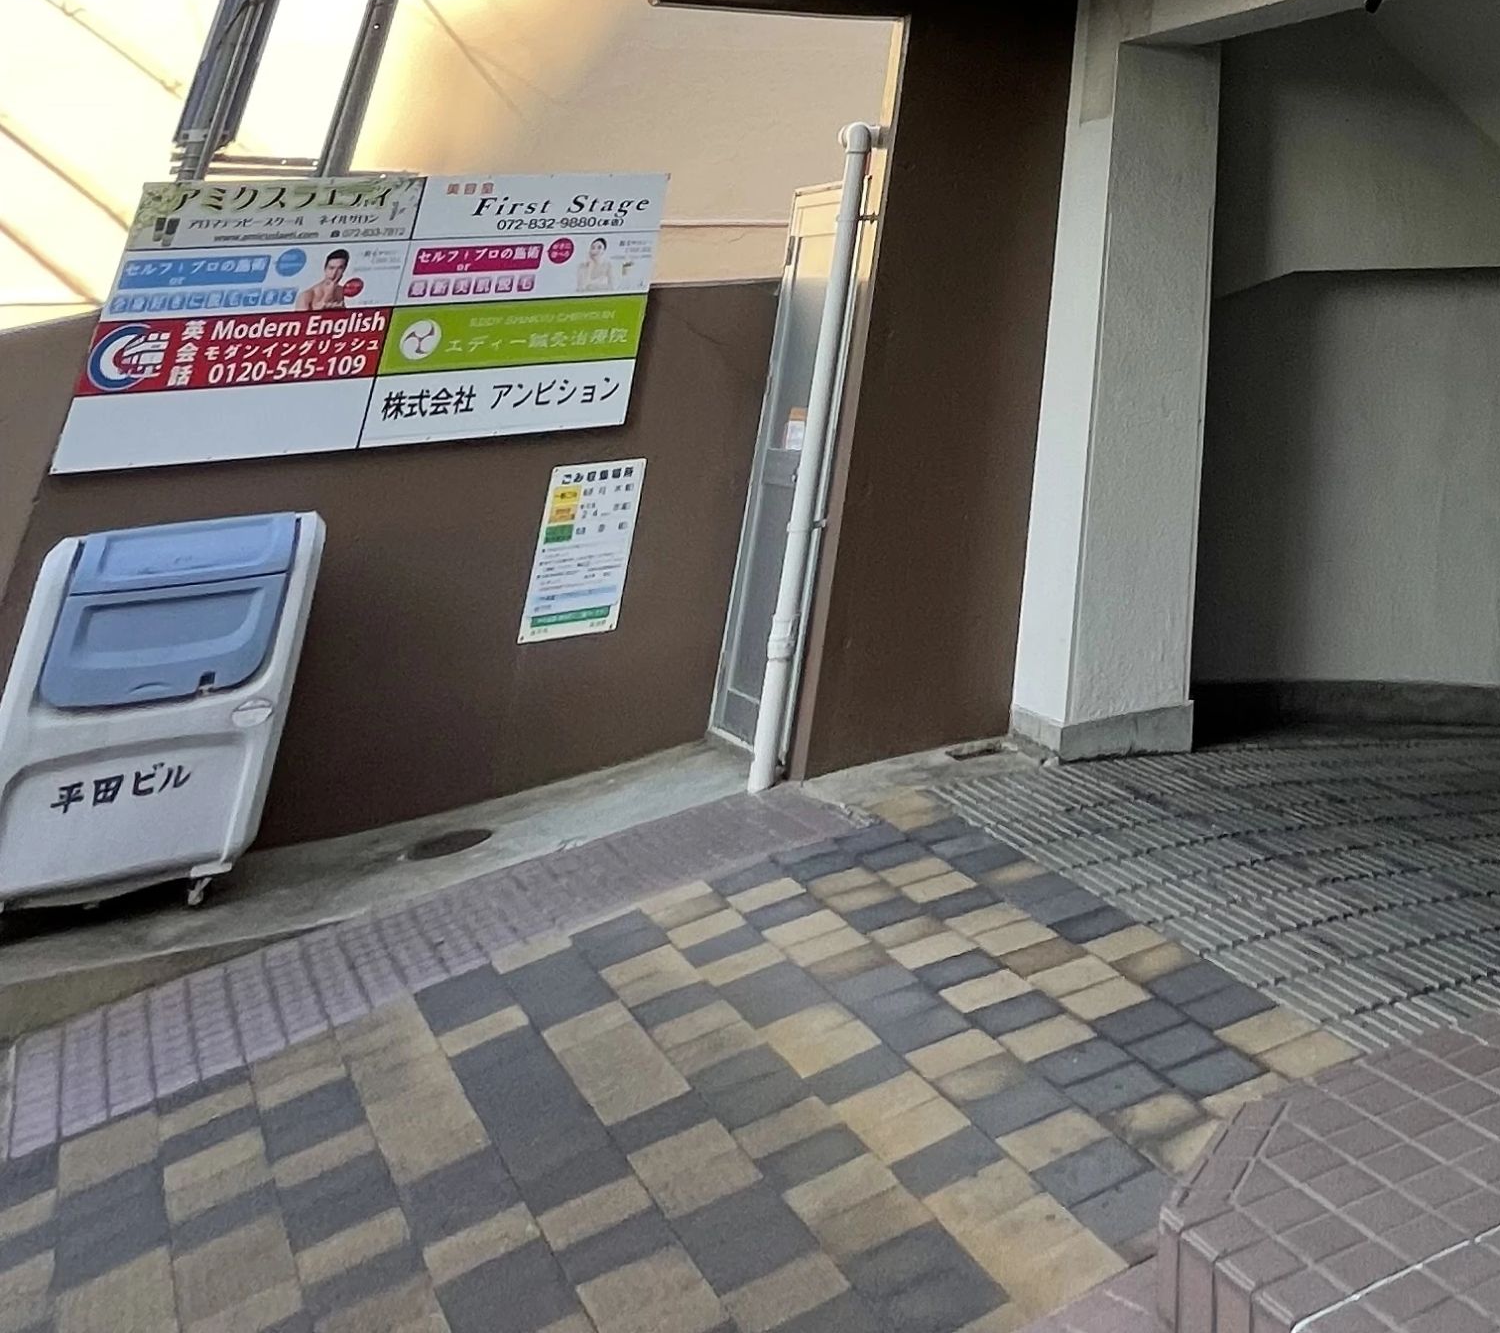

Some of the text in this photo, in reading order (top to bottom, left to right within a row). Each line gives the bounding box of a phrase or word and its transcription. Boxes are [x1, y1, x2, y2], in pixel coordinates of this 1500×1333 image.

[471, 194, 650, 217] First Stage
[210, 311, 386, 341] Modern English
[166, 319, 205, 387] 英会話
[208, 354, 367, 384] 0120-545-109
[380, 384, 477, 422] 株式会社
[49, 761, 192, 815] 平田ビル
